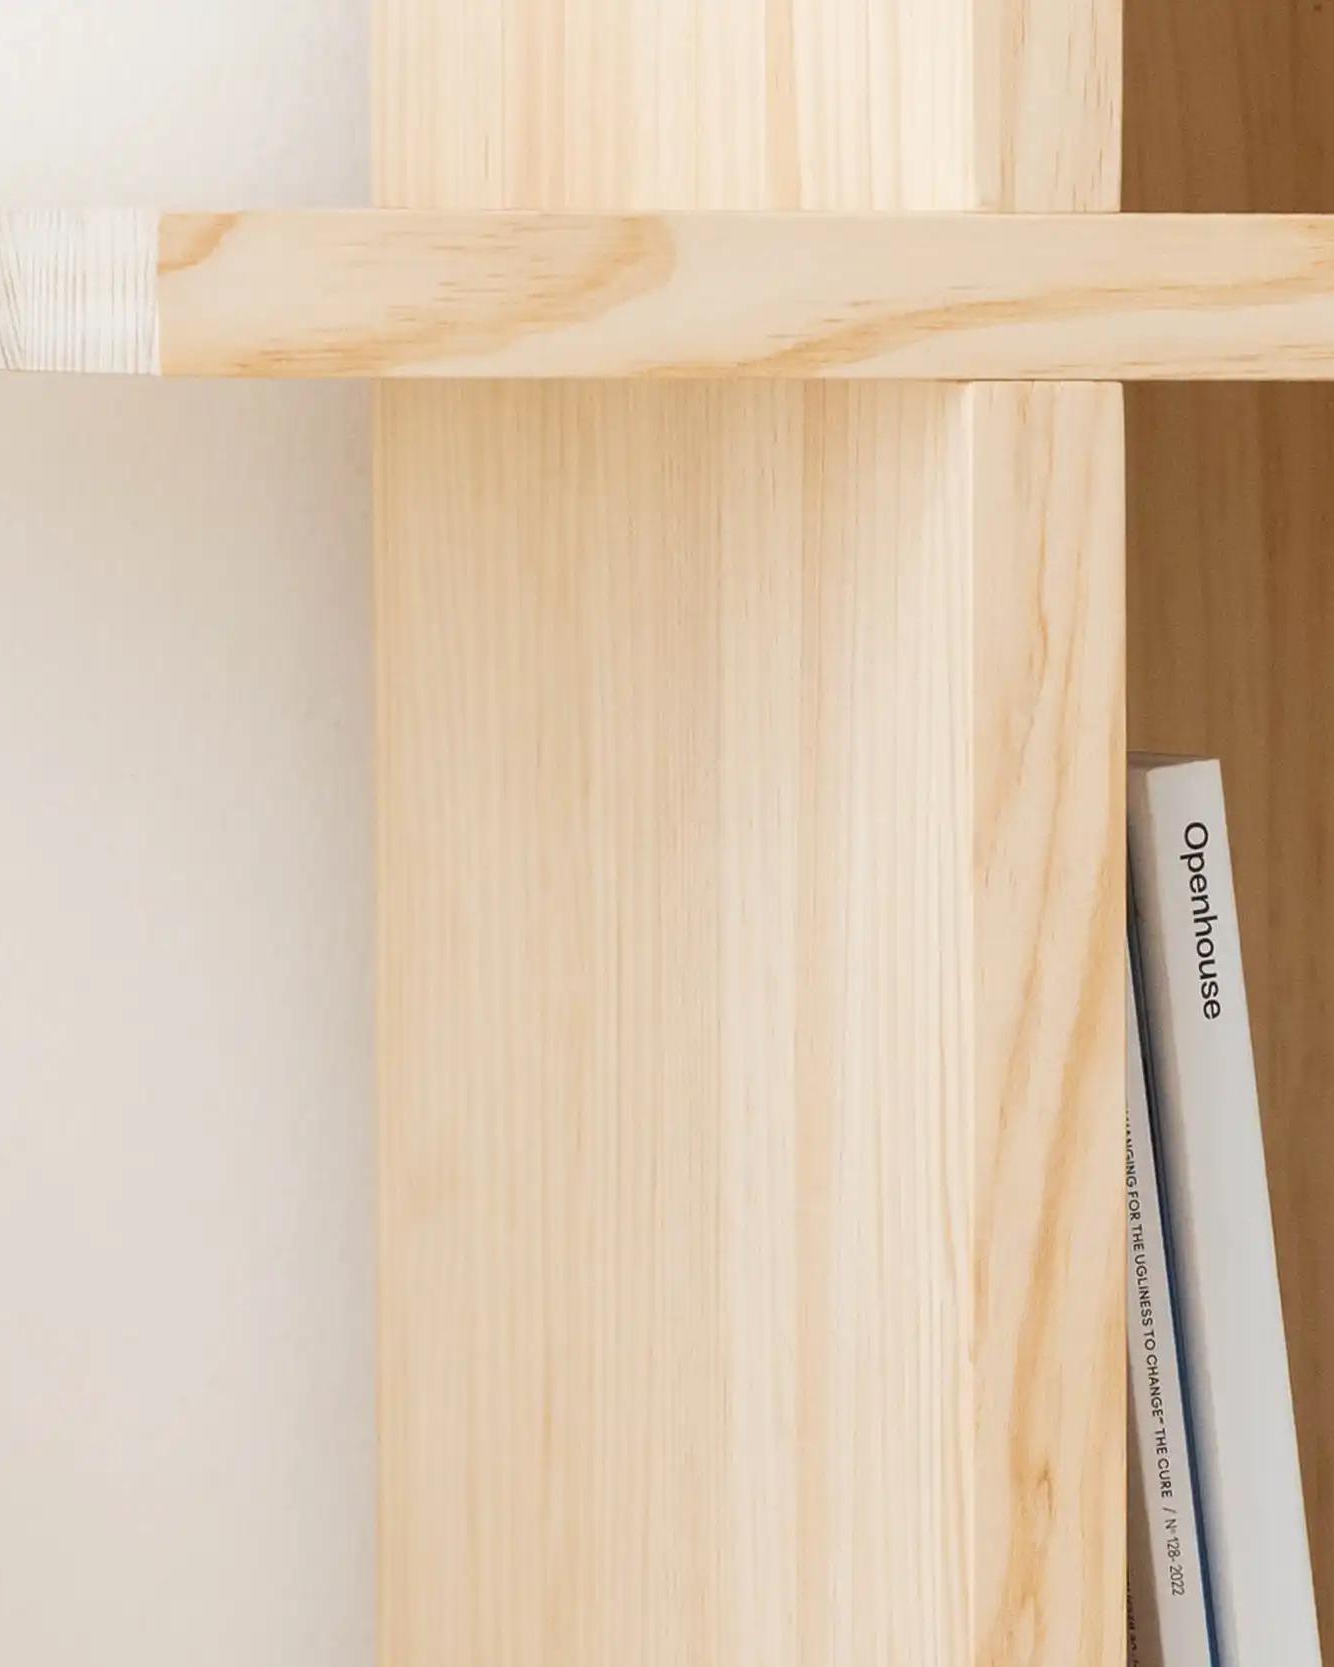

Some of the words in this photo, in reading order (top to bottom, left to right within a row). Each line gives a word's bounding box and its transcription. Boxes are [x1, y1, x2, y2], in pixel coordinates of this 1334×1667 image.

[1180, 821, 1221, 1020] Openhouse
[1128, 1190, 1141, 1221] FOR
[1132, 1224, 1146, 1252] THE
[1134, 1254, 1154, 1327] UGLINESS
[1143, 1328, 1156, 1351] TO
[1154, 1428, 1168, 1454] THE
[1157, 1457, 1173, 1498] CURE
